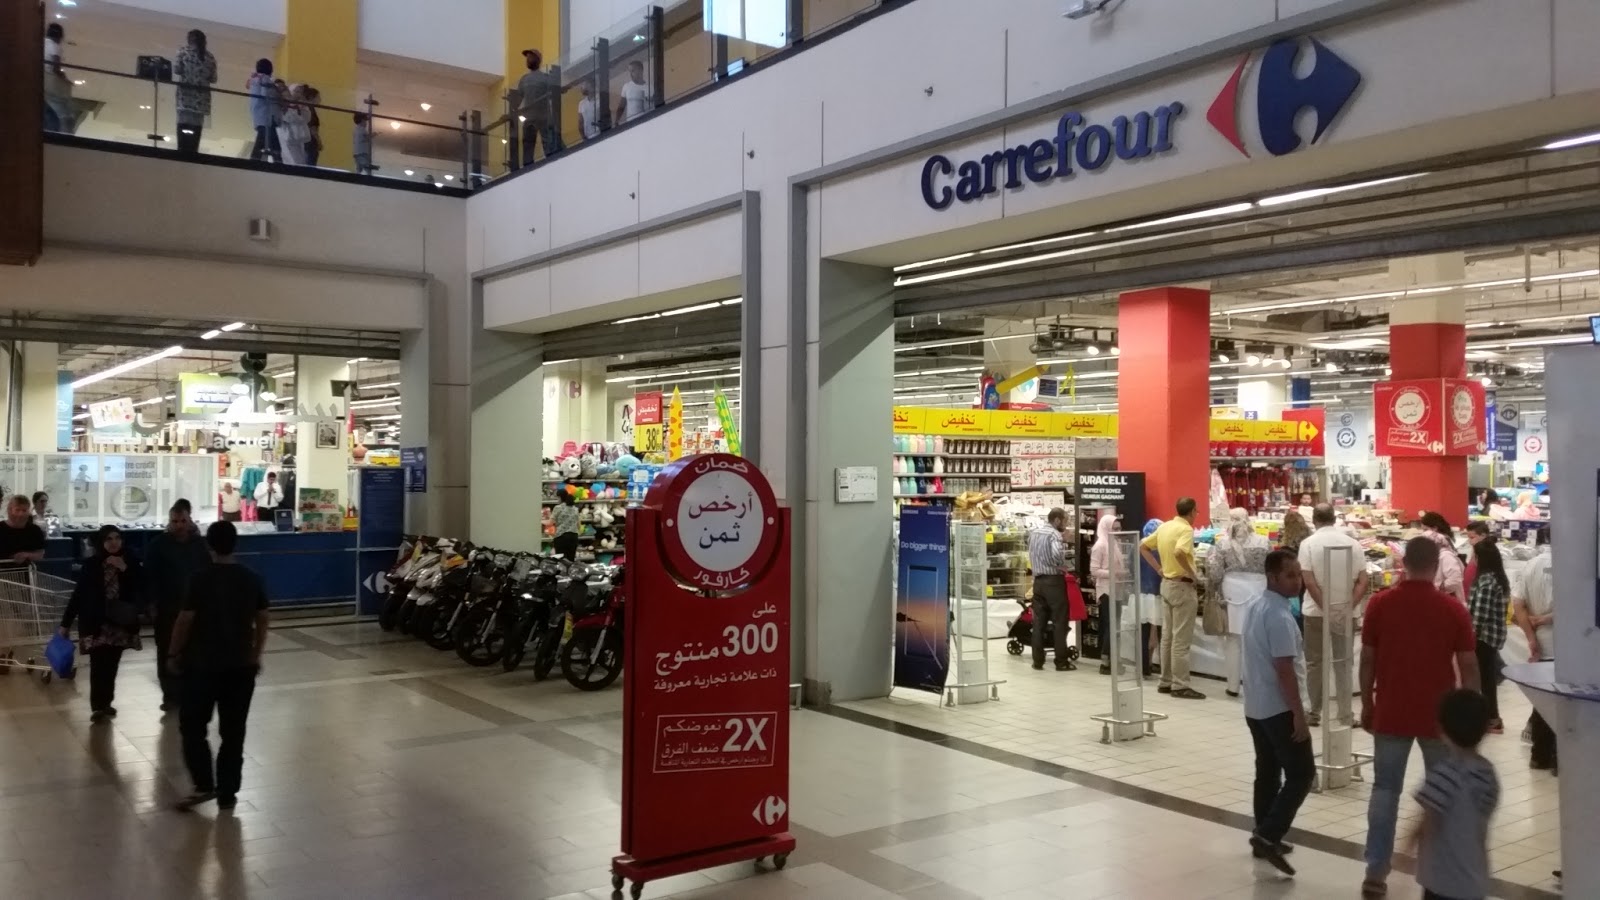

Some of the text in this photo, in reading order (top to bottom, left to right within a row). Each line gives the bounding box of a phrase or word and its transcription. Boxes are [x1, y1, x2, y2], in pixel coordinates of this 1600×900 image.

[921, 101, 1184, 210] Carrefour
[941, 412, 976, 428] تخفيض
[1005, 414, 1037, 429] تخفيض
[1065, 416, 1094, 430] تخفيض
[214, 435, 279, 451] accueil
[1409, 431, 1426, 444] 2X
[694, 457, 749, 474] ضمان
[1079, 475, 1128, 485] DURACELL
[688, 491, 753, 519] أرخص
[698, 522, 741, 549] ثمن
[910, 541, 928, 551] bigger
[929, 542, 946, 553] things
[693, 567, 750, 589] كارفور
[752, 602, 777, 618] على
[655, 622, 778, 676] 300 منتوج
[654, 667, 777, 693] ذات علامة تجارية معروفة
[722, 717, 769, 752] 2X
[661, 742, 719, 758] ضعف الفرق
